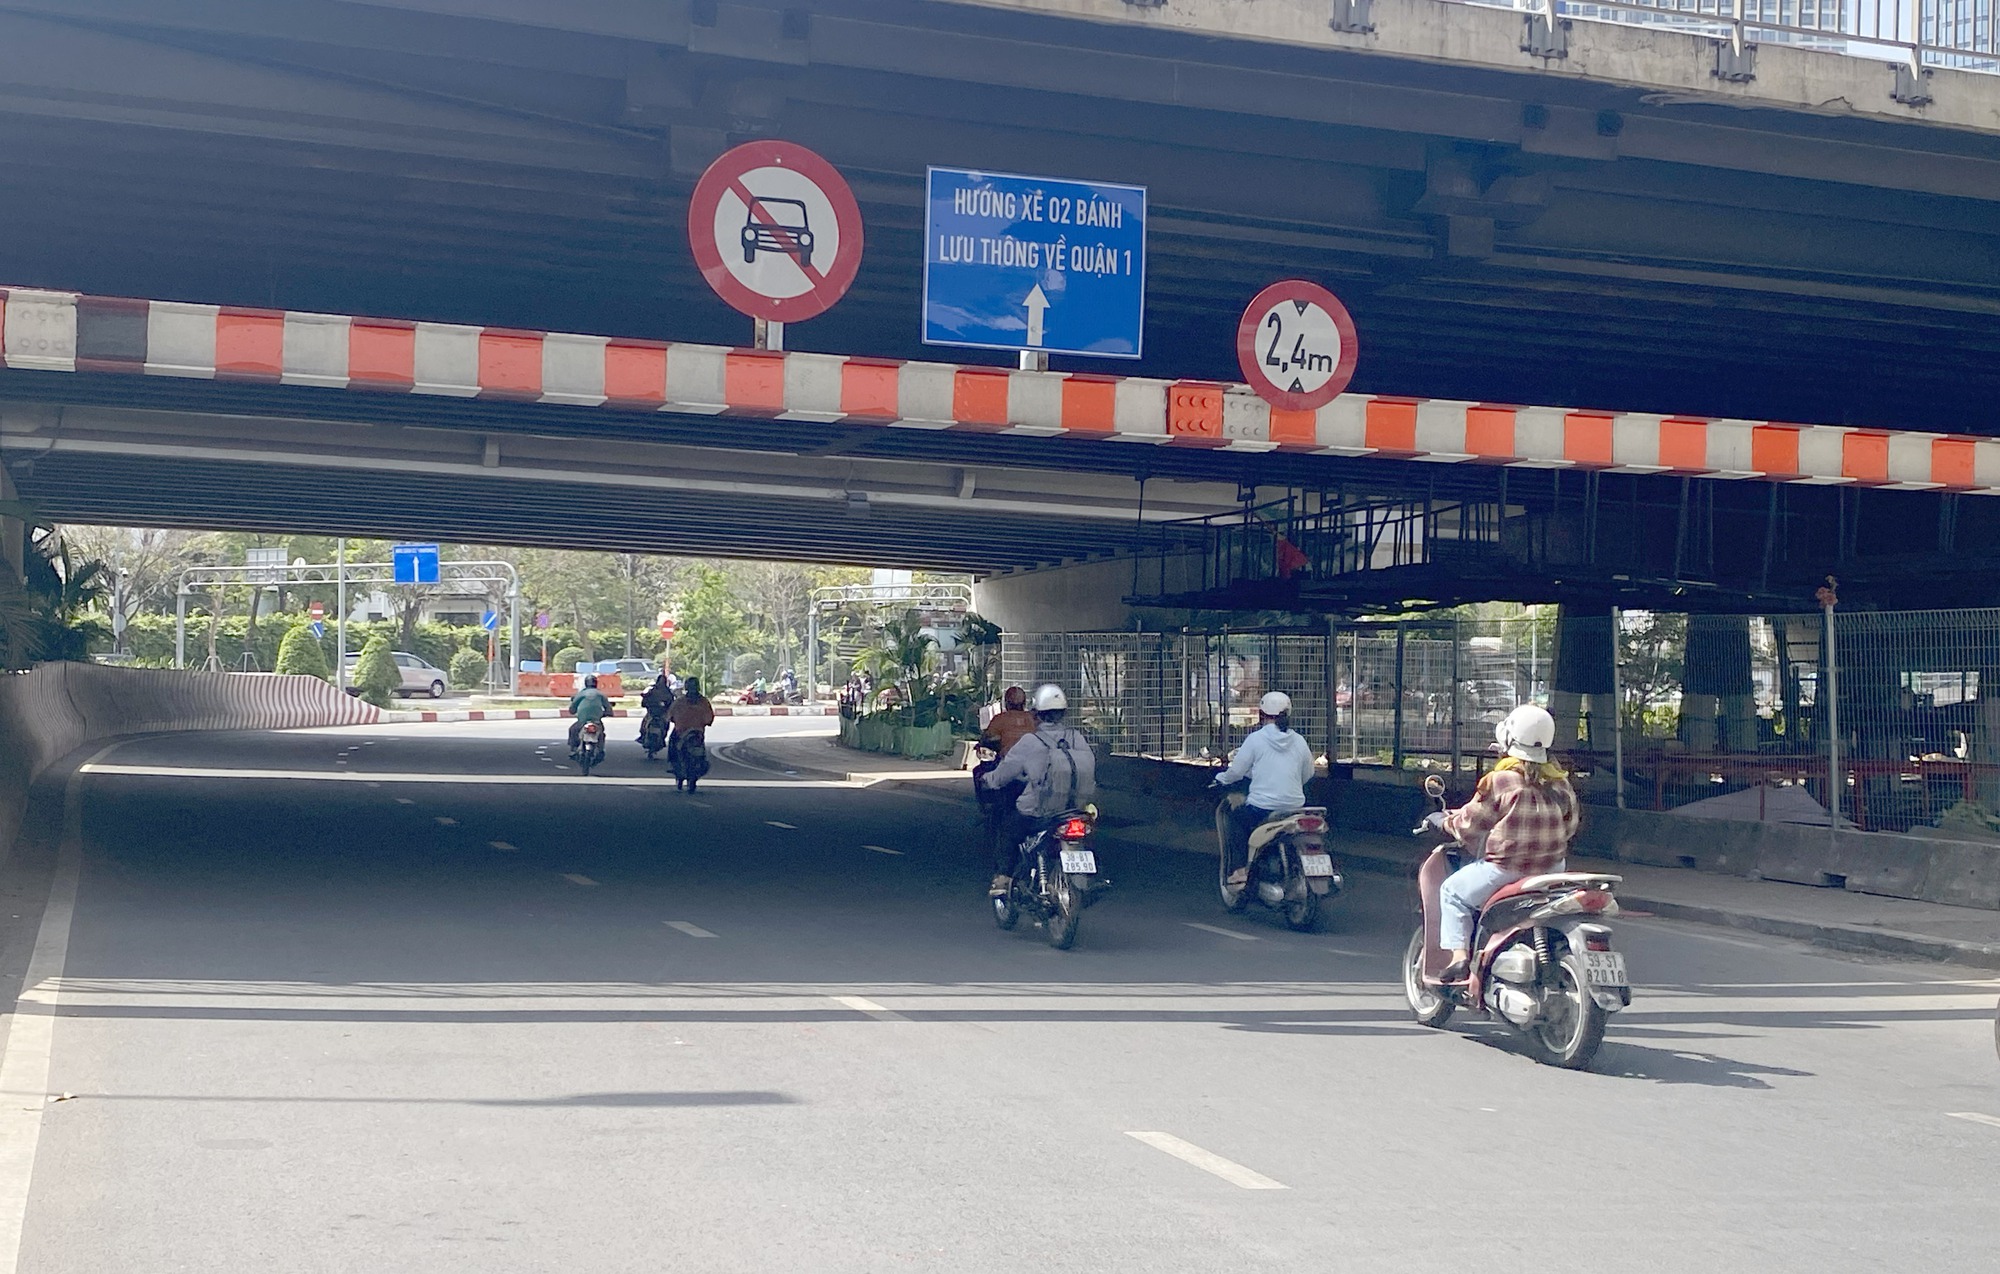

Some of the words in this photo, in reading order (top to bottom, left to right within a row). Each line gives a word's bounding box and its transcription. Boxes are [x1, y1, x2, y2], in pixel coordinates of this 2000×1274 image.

[954, 183, 1016, 220] HƯỚNG
[1049, 197, 1071, 225] 02
[1076, 193, 1122, 229] BÁNH
[939, 234, 974, 264] LƯU
[980, 235, 1040, 269] THÔNG
[1044, 234, 1066, 271] VỀ
[1071, 242, 1118, 278] QUẬN
[1124, 250, 1131, 276] 1
[1265, 312, 1333, 373] 2,4m
